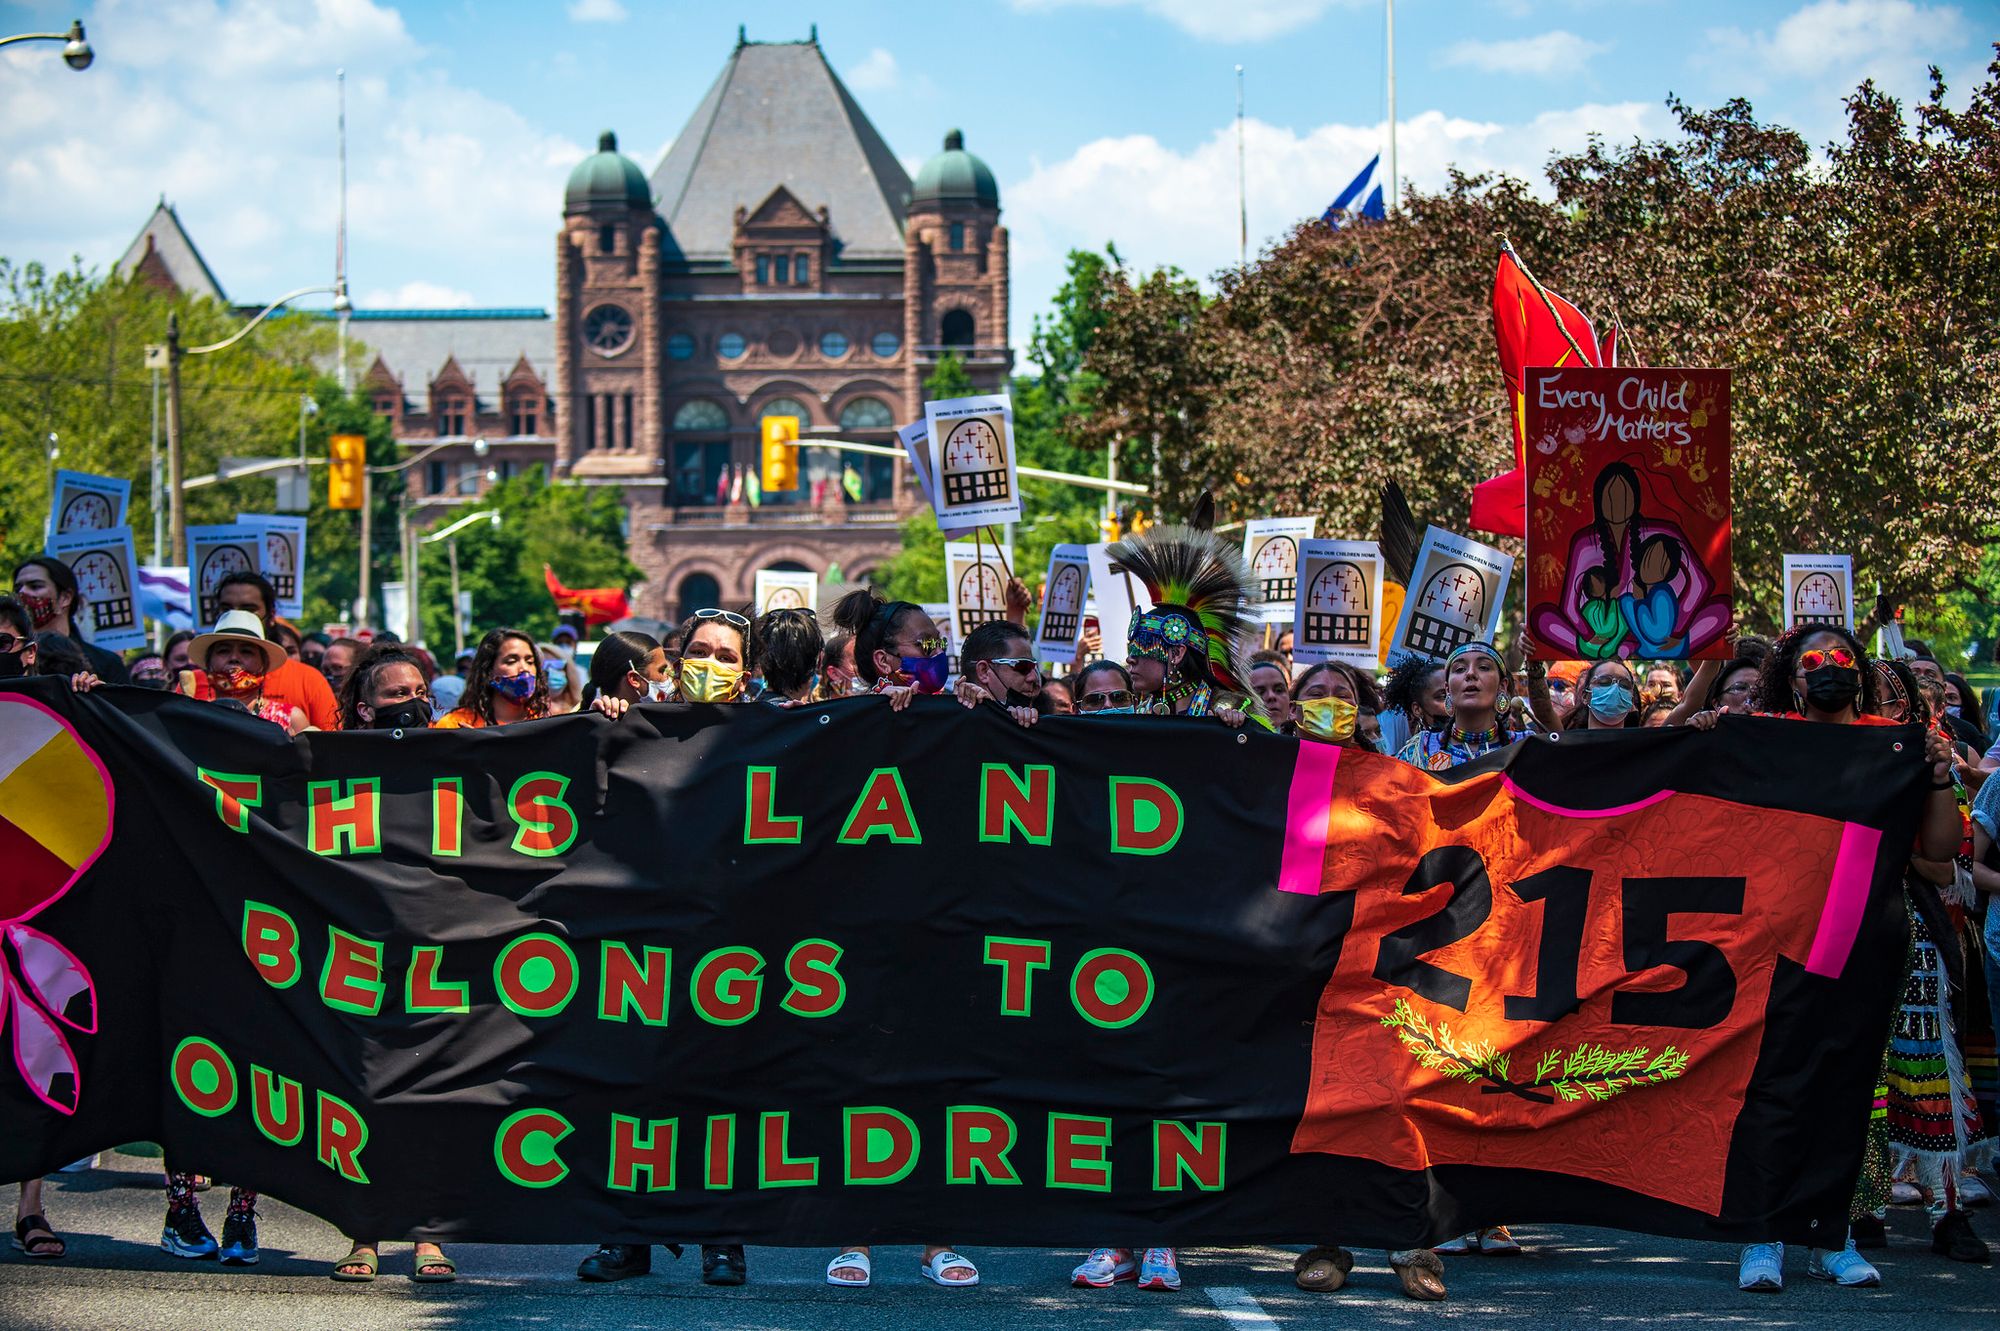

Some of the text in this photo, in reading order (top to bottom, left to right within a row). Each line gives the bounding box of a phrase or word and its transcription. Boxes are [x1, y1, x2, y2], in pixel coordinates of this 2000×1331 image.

[1538, 372, 1689, 433] Every Child
[1599, 413, 1692, 445] Matters
[1433, 541, 1503, 573] BRING OUR CHILDREN HOME
[198, 763, 1185, 857] THIS LAND
[242, 900, 1155, 1029] BELONGS TO
[1372, 845, 1747, 1030] 215
[171, 1036, 1227, 1193] OUR CHILDREN
